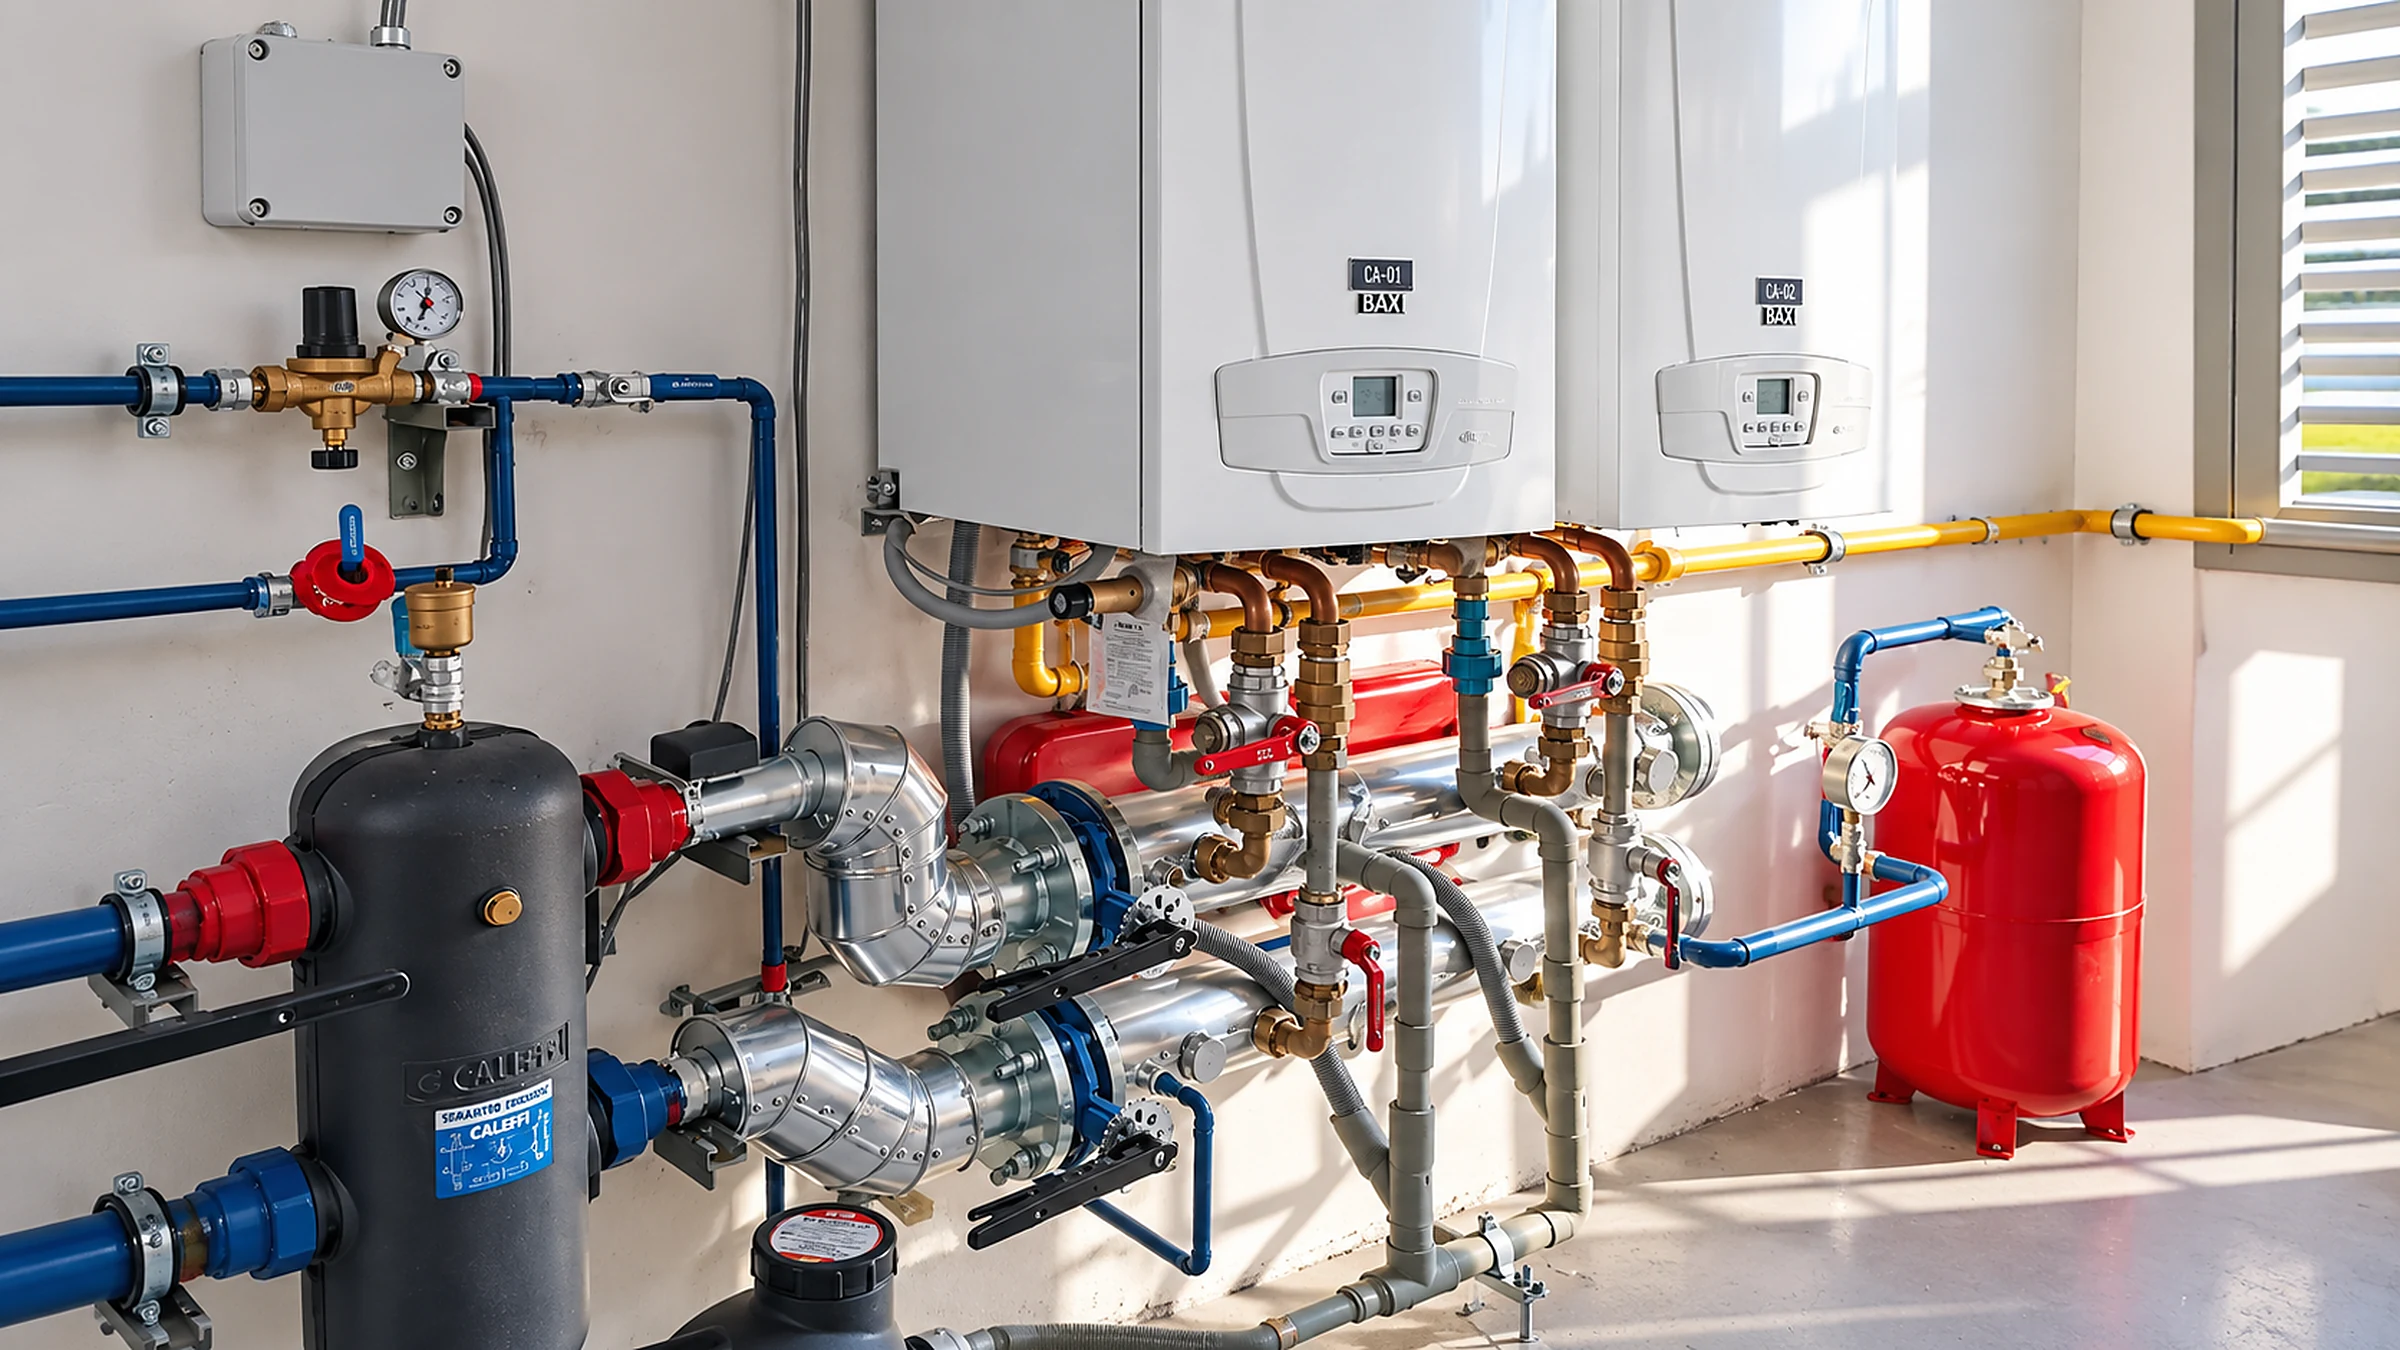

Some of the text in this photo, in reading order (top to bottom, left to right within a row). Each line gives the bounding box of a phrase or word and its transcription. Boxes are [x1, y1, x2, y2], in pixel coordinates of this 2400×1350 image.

[1364, 265, 1401, 284] CA-01
[1766, 282, 1796, 300] CA-02
[469, 1110, 530, 1141] CALEFFI
